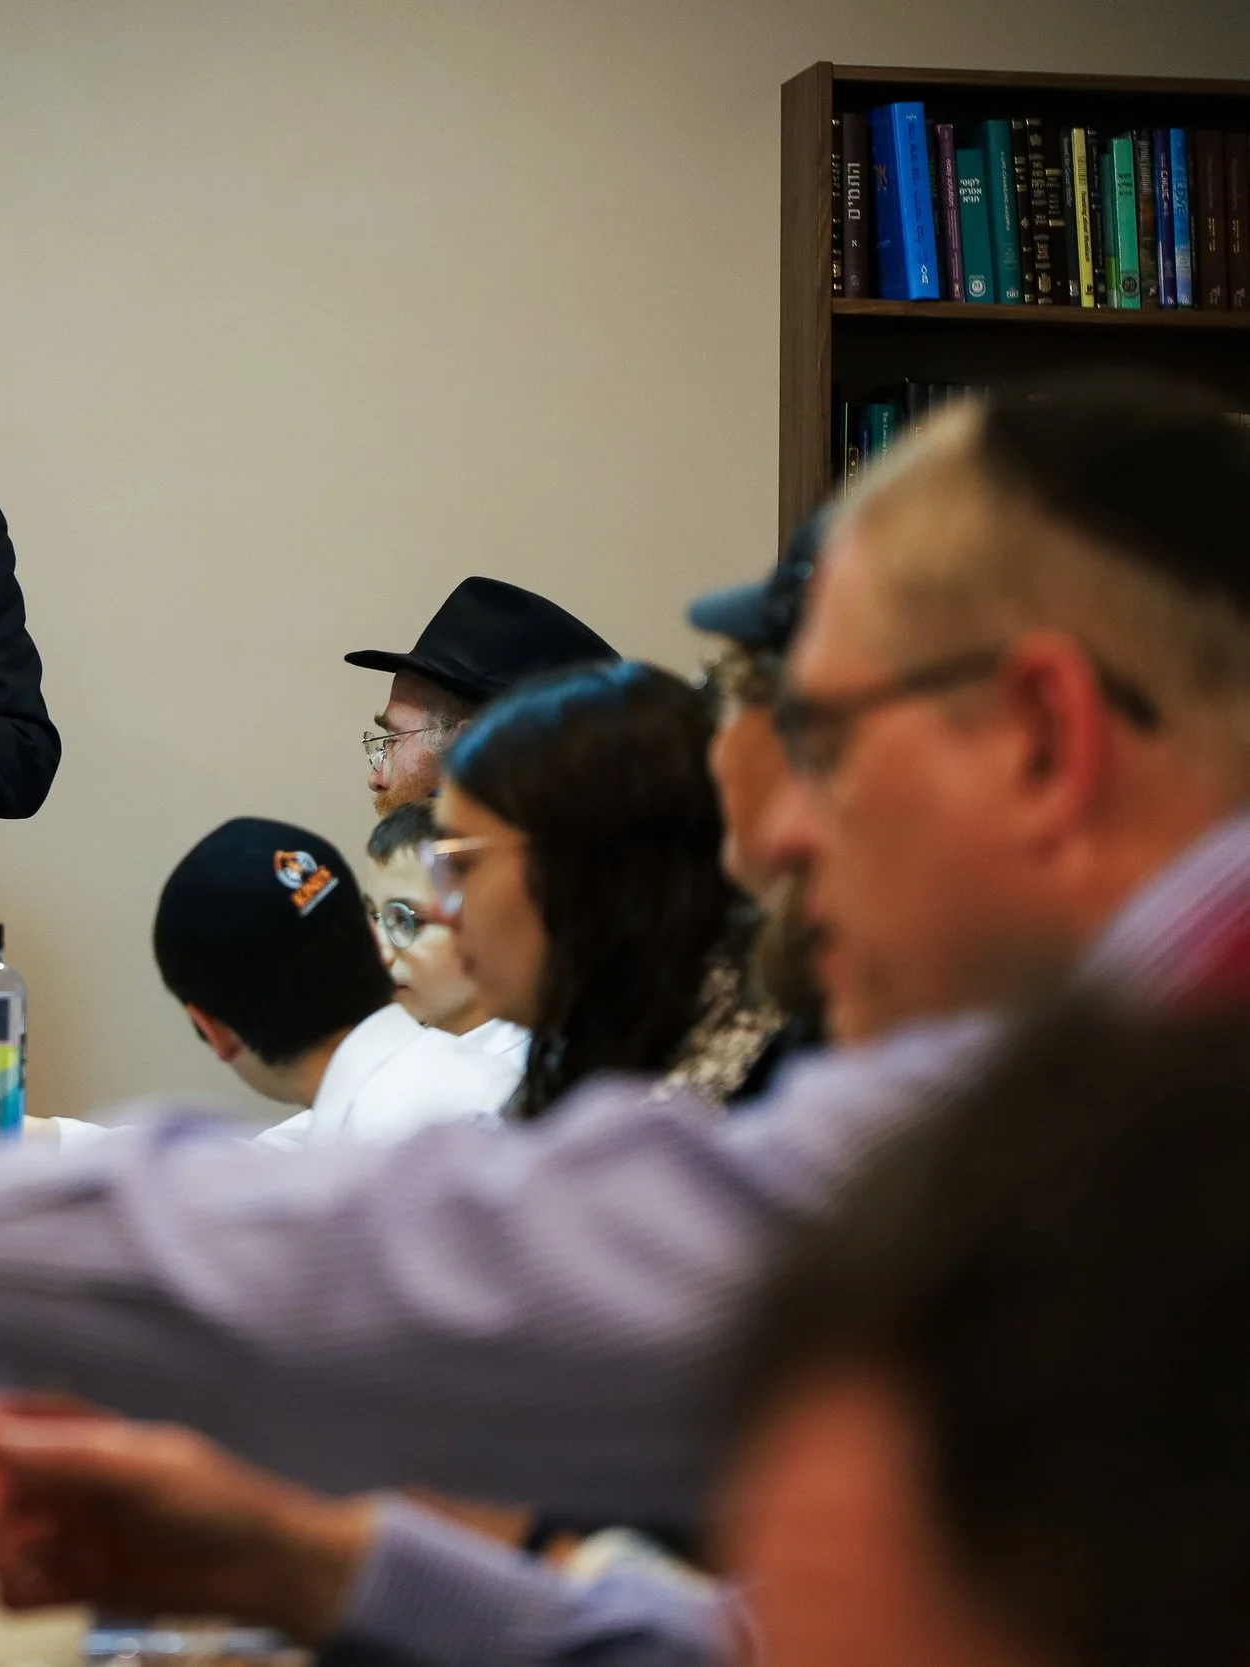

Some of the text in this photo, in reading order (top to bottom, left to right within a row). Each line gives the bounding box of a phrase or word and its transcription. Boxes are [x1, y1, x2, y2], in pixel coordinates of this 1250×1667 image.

[959, 177, 980, 187] לקוטי
[848, 162, 861, 220] התמים
[959, 187, 982, 196] אמרים
[962, 195, 980, 203] תניא
